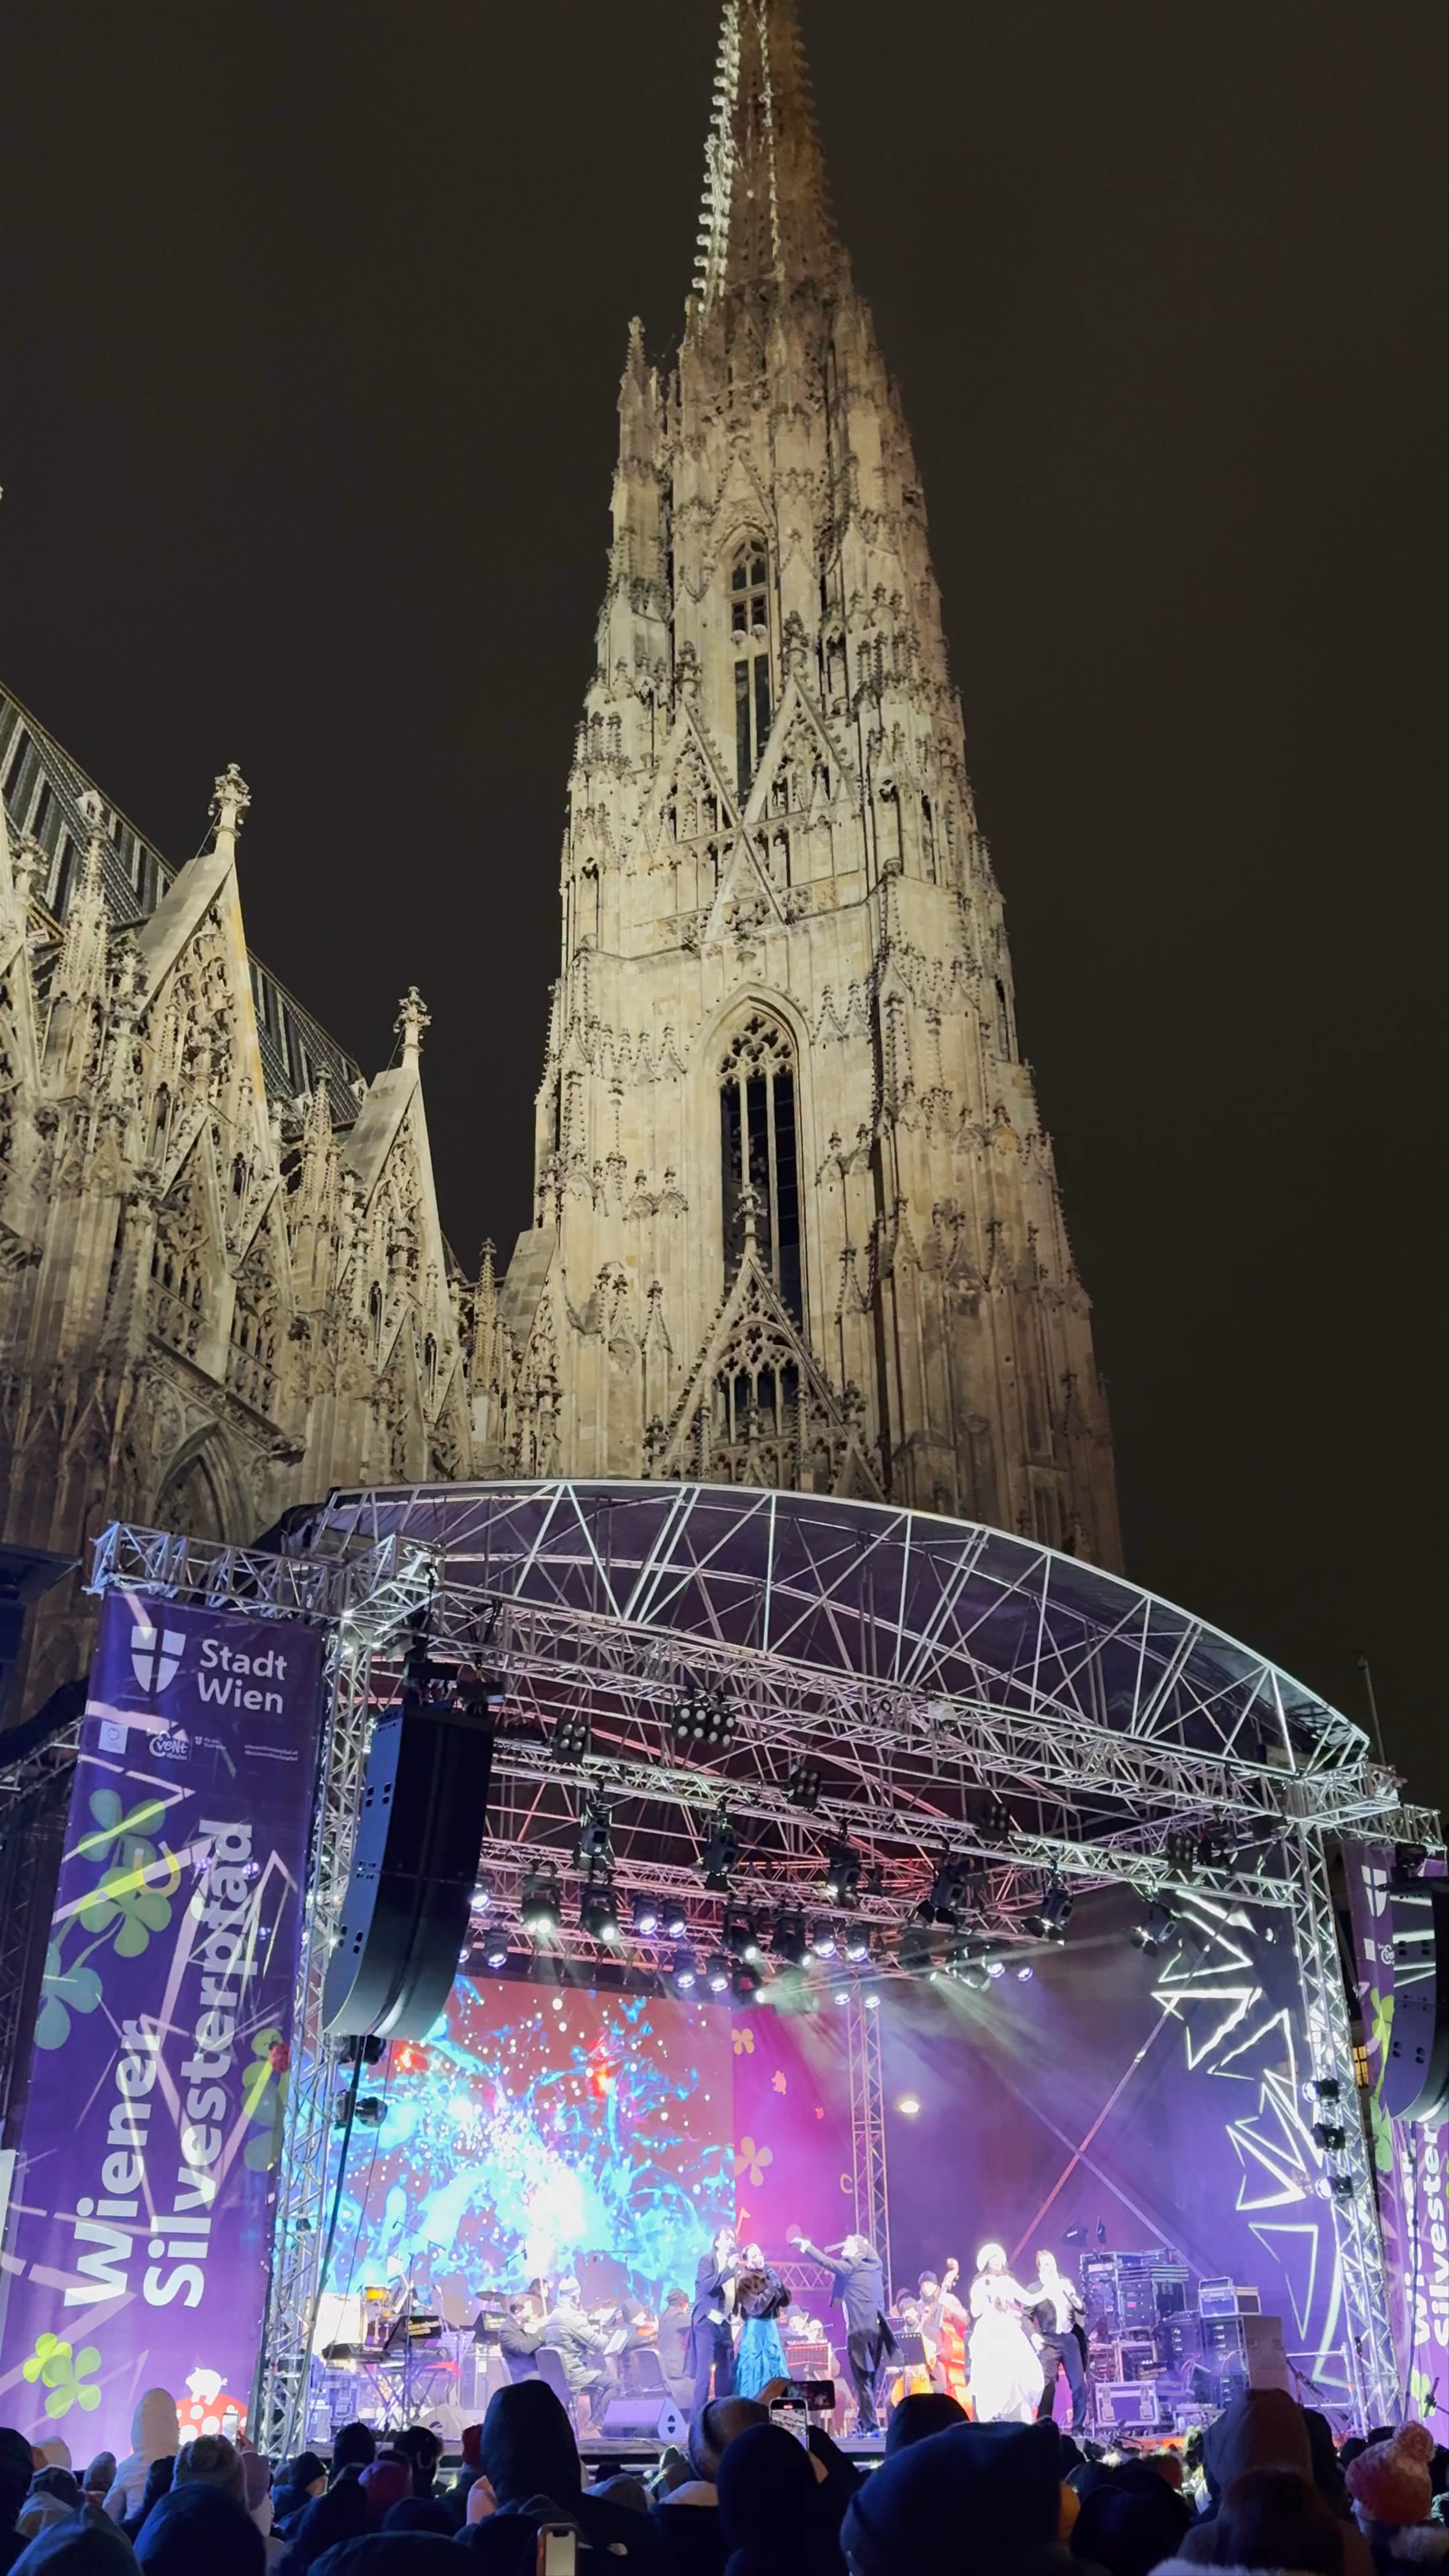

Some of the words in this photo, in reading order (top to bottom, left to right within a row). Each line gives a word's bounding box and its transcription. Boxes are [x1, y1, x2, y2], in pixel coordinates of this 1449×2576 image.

[197, 1673, 283, 1714] Wien
[200, 1639, 287, 1681] Stadt
[63, 2020, 161, 2307] Wiener
[143, 1819, 258, 2308] Silvesterpfad
[1423, 2122, 1449, 2347] Silvester
